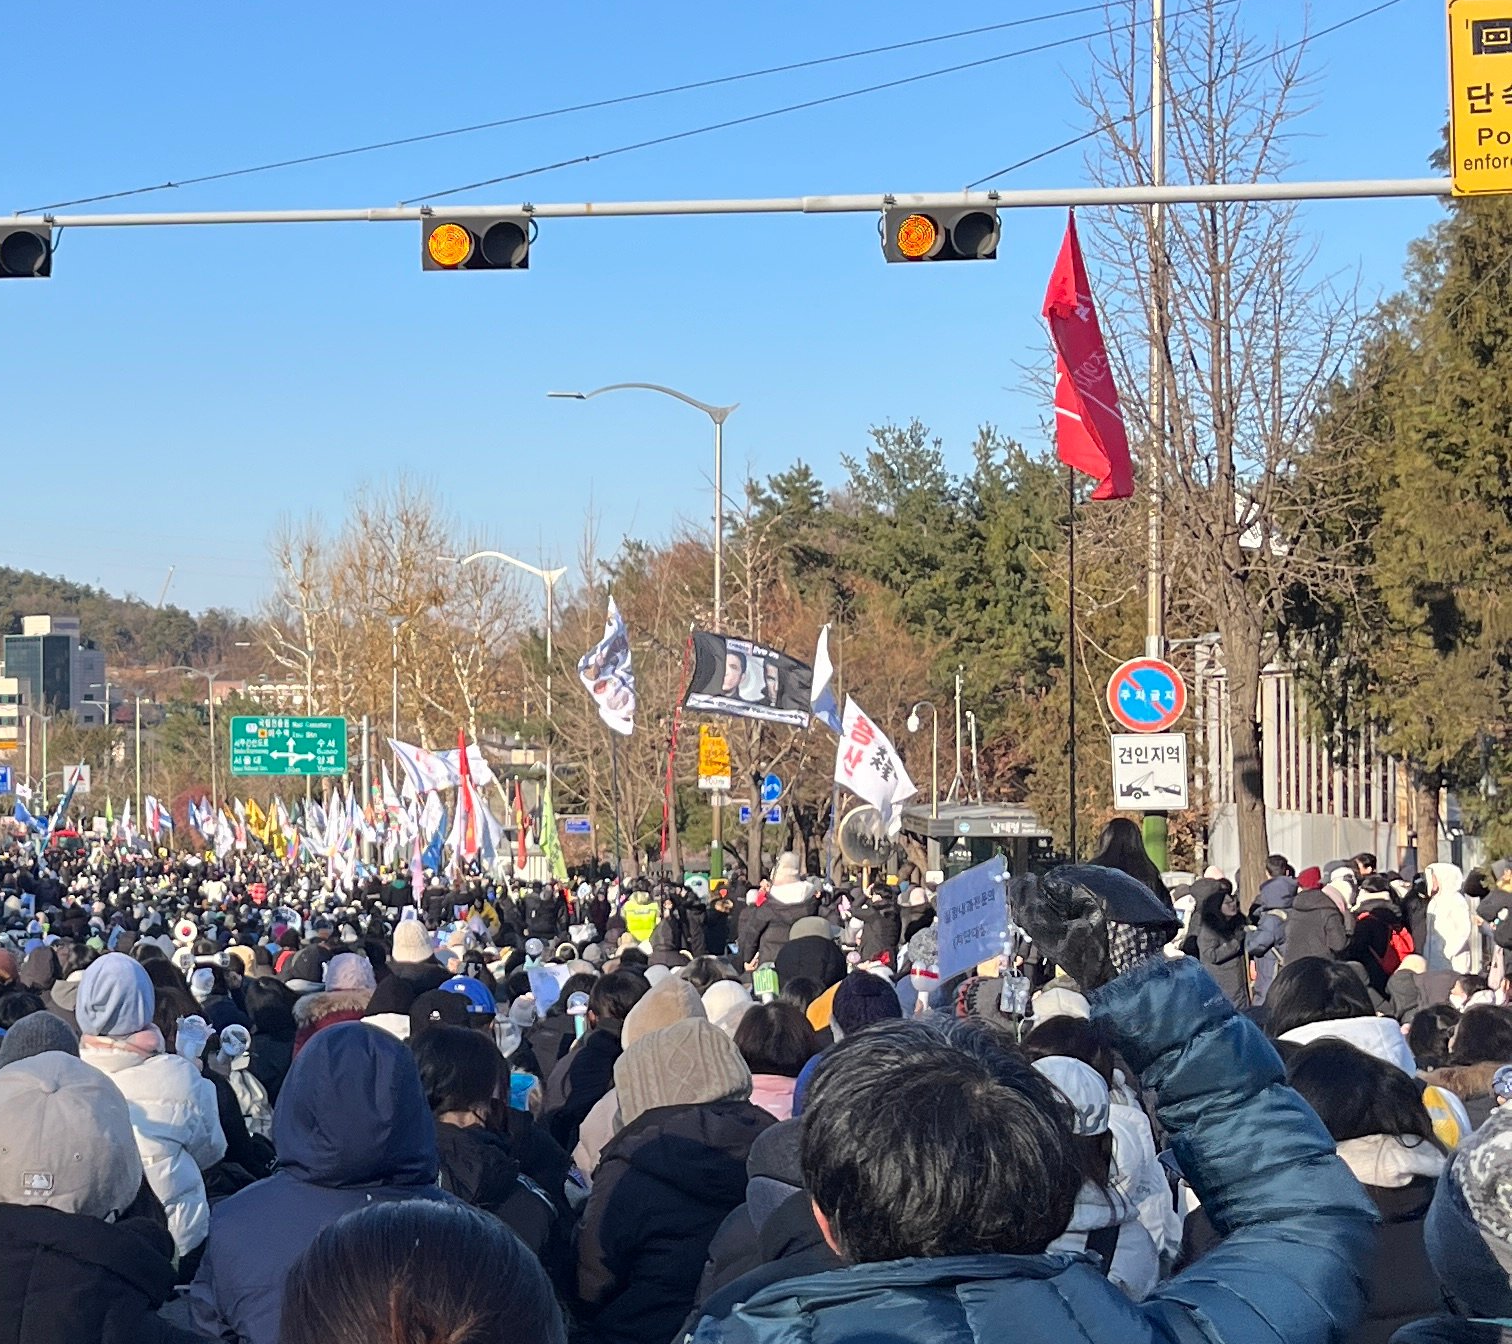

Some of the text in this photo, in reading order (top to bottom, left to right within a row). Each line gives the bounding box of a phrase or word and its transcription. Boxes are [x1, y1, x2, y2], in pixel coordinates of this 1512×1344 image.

[1464, 153, 1512, 171] enfor
[1119, 689, 1176, 702] 주차금지
[843, 714, 875, 777] 용산
[1118, 745, 1180, 765] 견인지역
